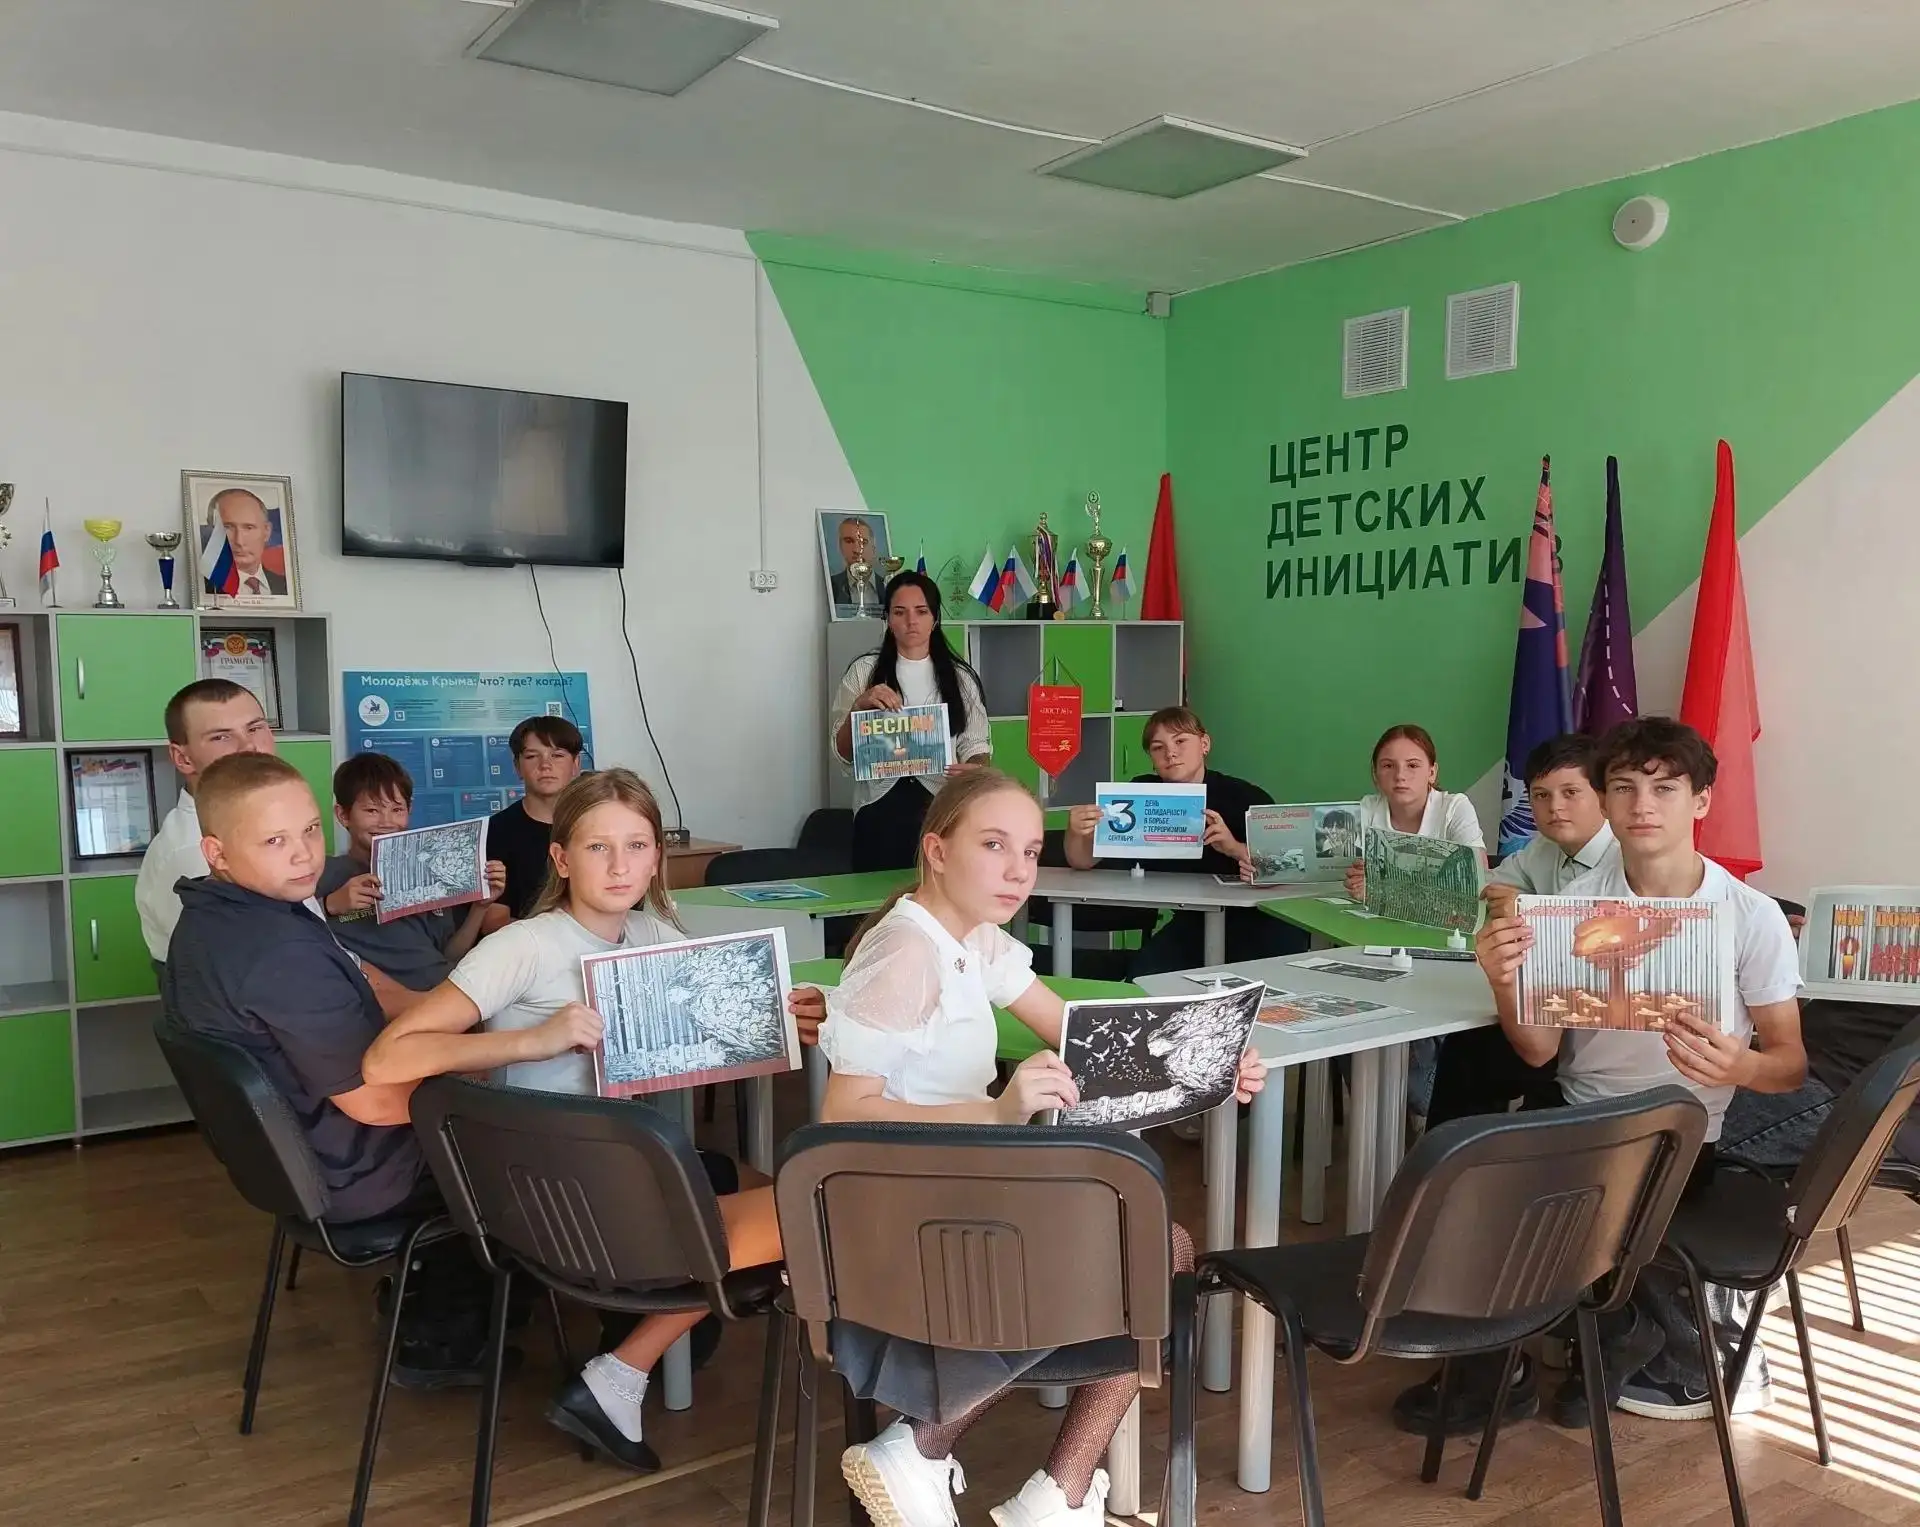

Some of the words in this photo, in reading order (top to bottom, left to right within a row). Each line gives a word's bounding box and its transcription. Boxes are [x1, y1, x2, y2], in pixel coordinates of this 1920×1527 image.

[1268, 423, 1409, 489] ЦЕНТР
[1266, 475, 1487, 549] ДЕТСКИХ
[220, 657, 255, 665] ГРАМОТА
[361, 675, 429, 687] Молодёжь
[432, 675, 478, 688] Крыма:
[480, 677, 505, 686] что?
[508, 677, 532, 687] где?
[535, 677, 573, 687] когда?
[860, 714, 934, 736] БЕСЛАН
[1107, 800, 1137, 834] 3
[1108, 834, 1134, 842] СЕНТЯБРЯ
